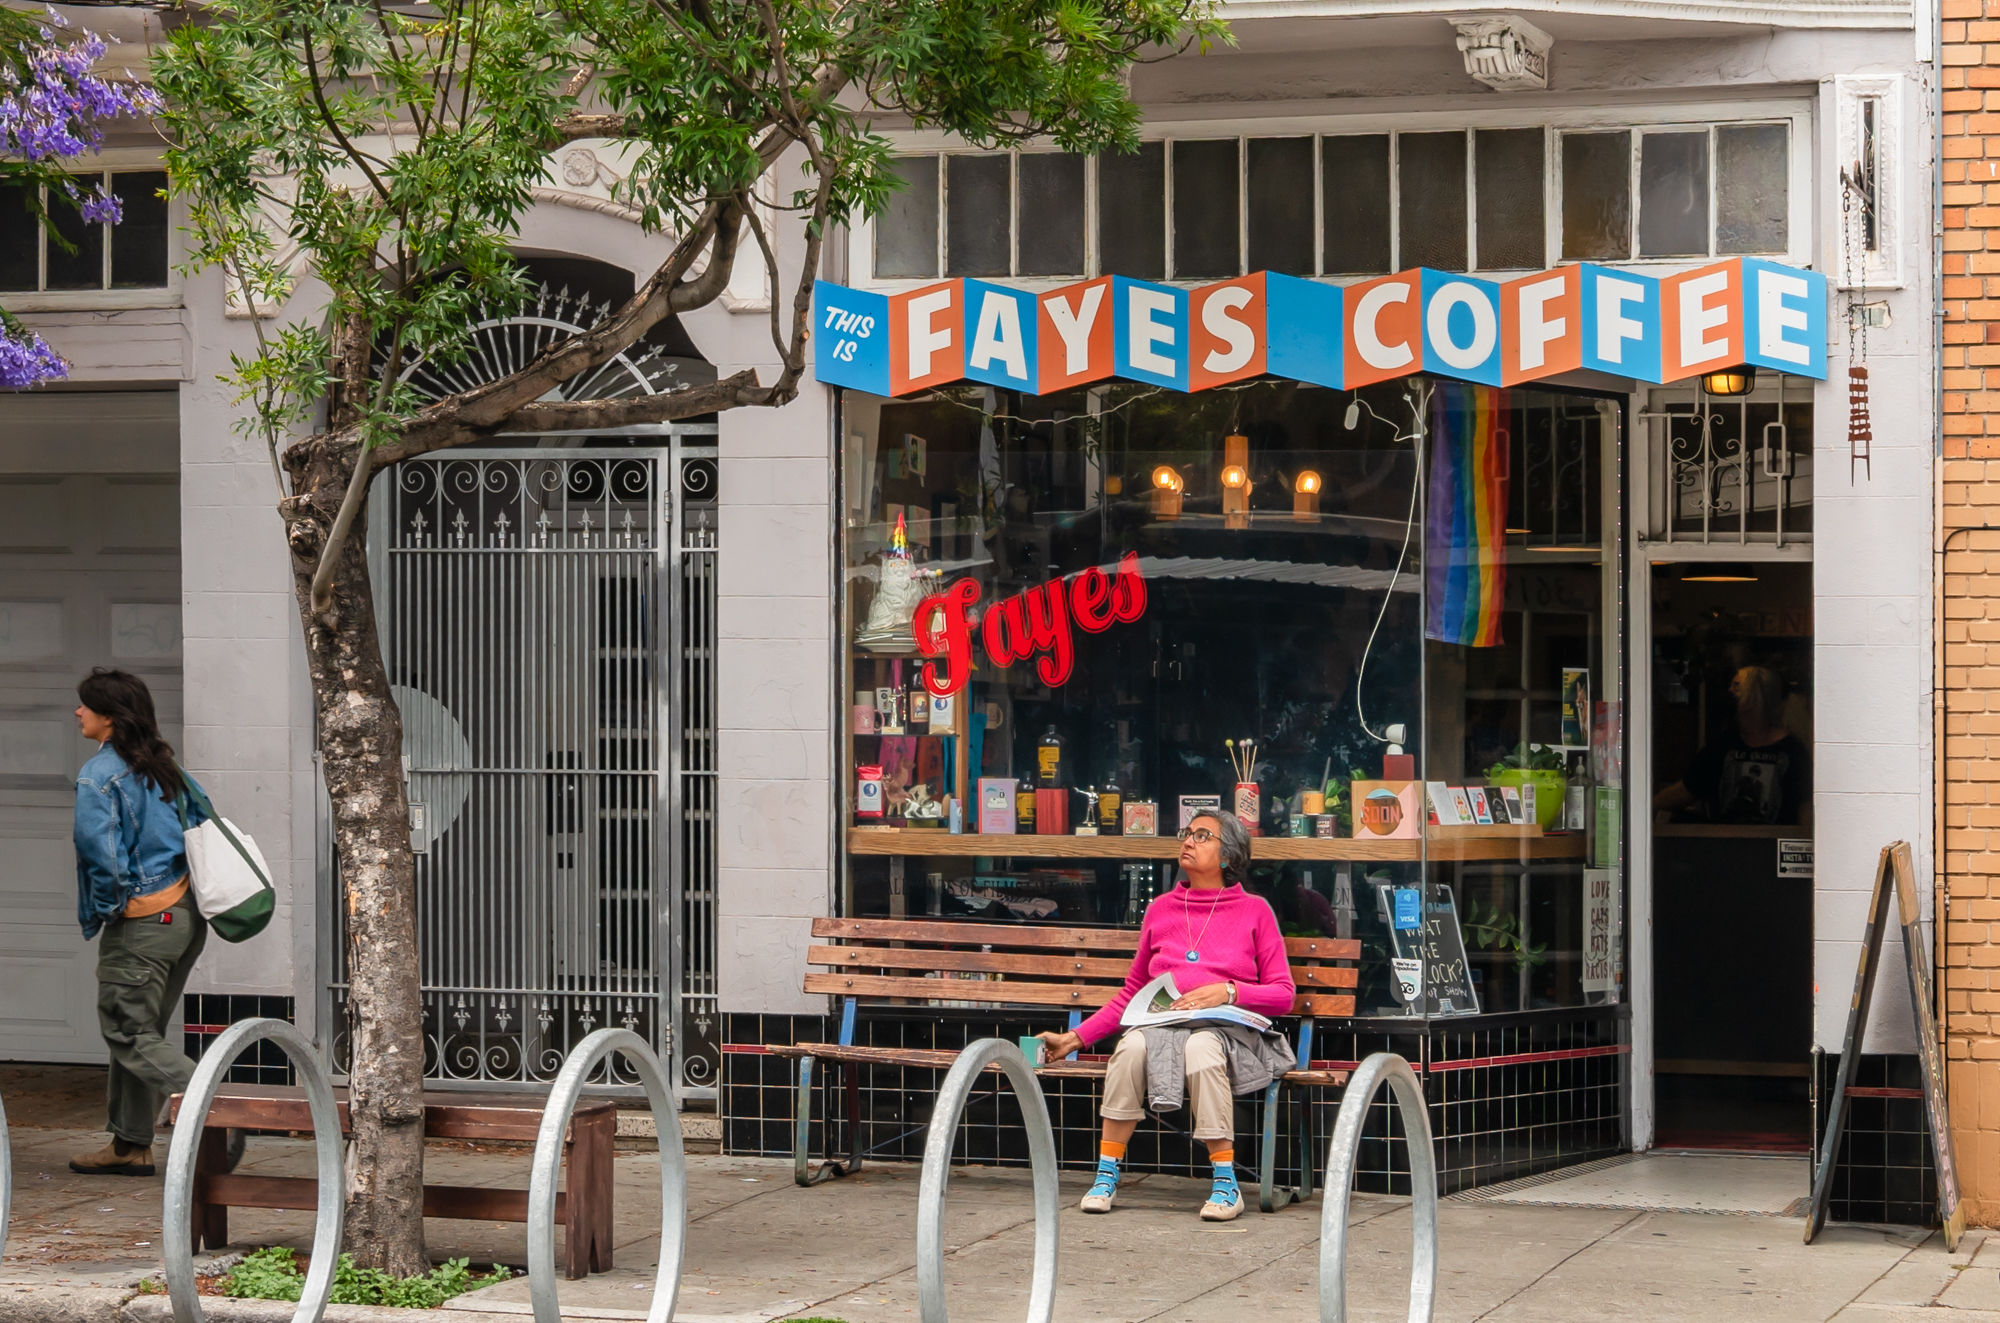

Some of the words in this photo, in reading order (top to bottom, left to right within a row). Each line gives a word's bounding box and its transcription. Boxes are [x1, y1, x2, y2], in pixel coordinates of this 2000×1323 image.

[824, 305, 876, 340] THIS
[907, 277, 1256, 382] FAYES
[1352, 269, 1811, 371] COFFEE
[832, 338, 858, 364] IS
[911, 549, 1148, 700] Fayes
[1600, 798, 1617, 810] PASS
[1361, 805, 1401, 824] SOON
[1590, 880, 1610, 899] LOVE
[1590, 907, 1609, 925] CATS
[1405, 919, 1441, 938] WHAT
[1590, 934, 1608, 955] HATE
[1586, 961, 1615, 980] RACISM
[1444, 985, 1468, 999] SHOW
